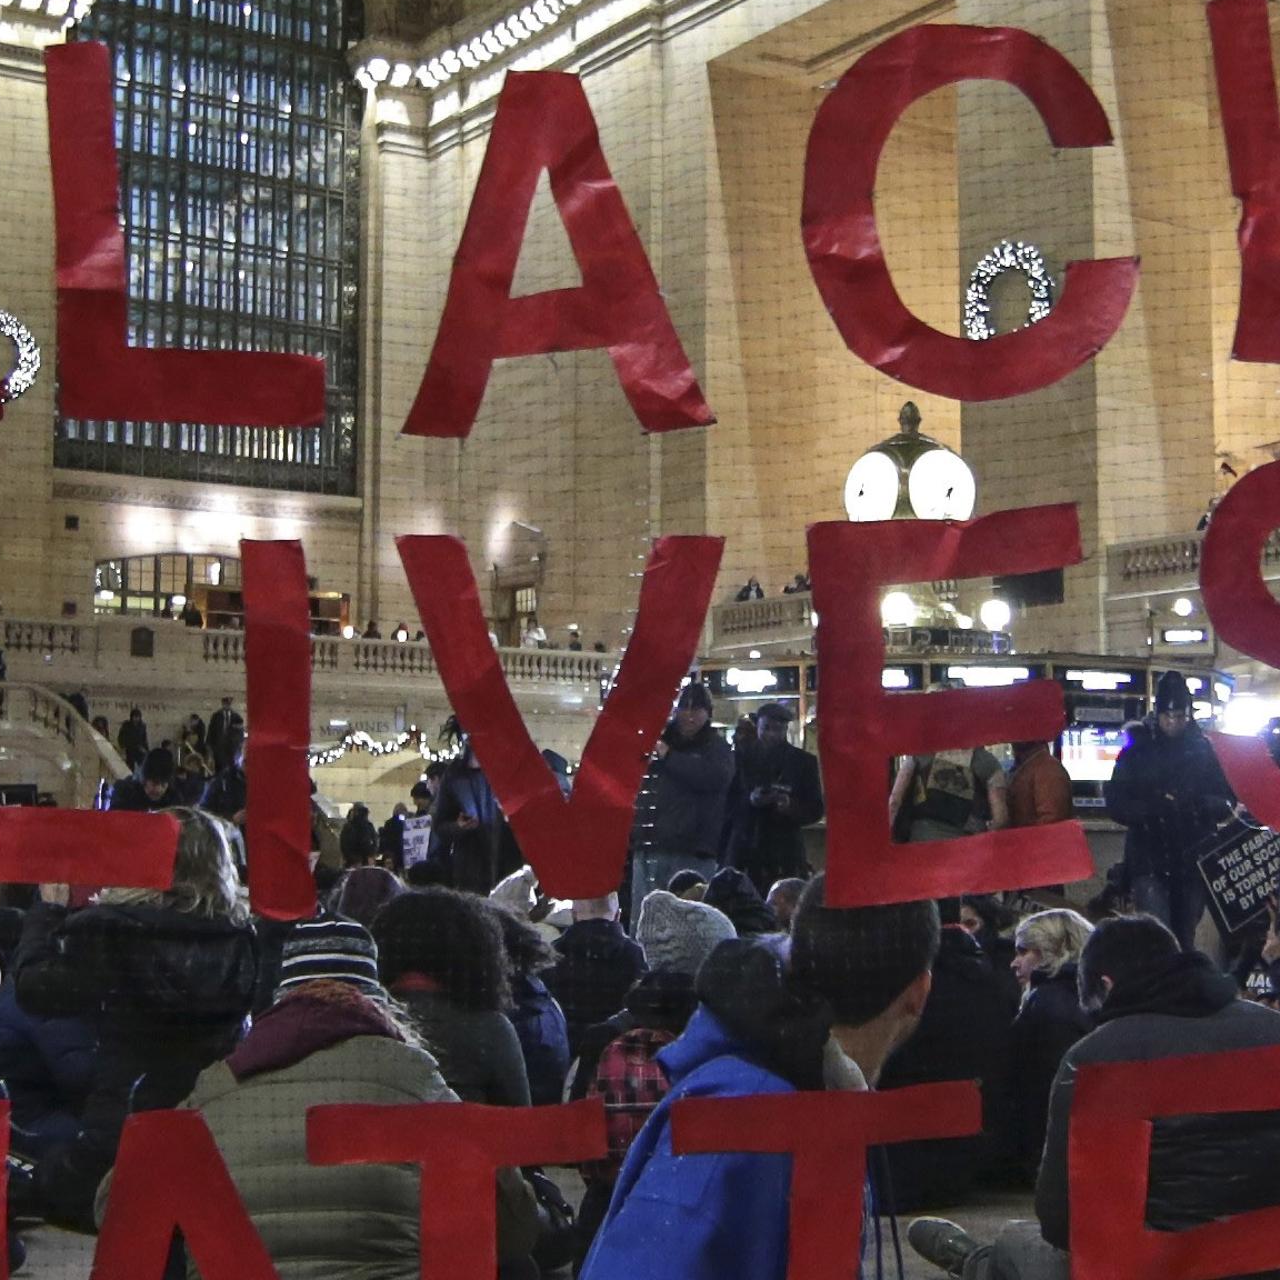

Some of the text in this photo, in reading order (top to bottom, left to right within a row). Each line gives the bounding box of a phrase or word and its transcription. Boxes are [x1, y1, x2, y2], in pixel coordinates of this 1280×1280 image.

[1217, 848, 1243, 871] THE
[1212, 875, 1227, 893] OF
[1229, 859, 1254, 882] OUR
[1222, 888, 1236, 904] IS
[1235, 867, 1267, 895] TORN
[1239, 890, 1255, 910] BY
